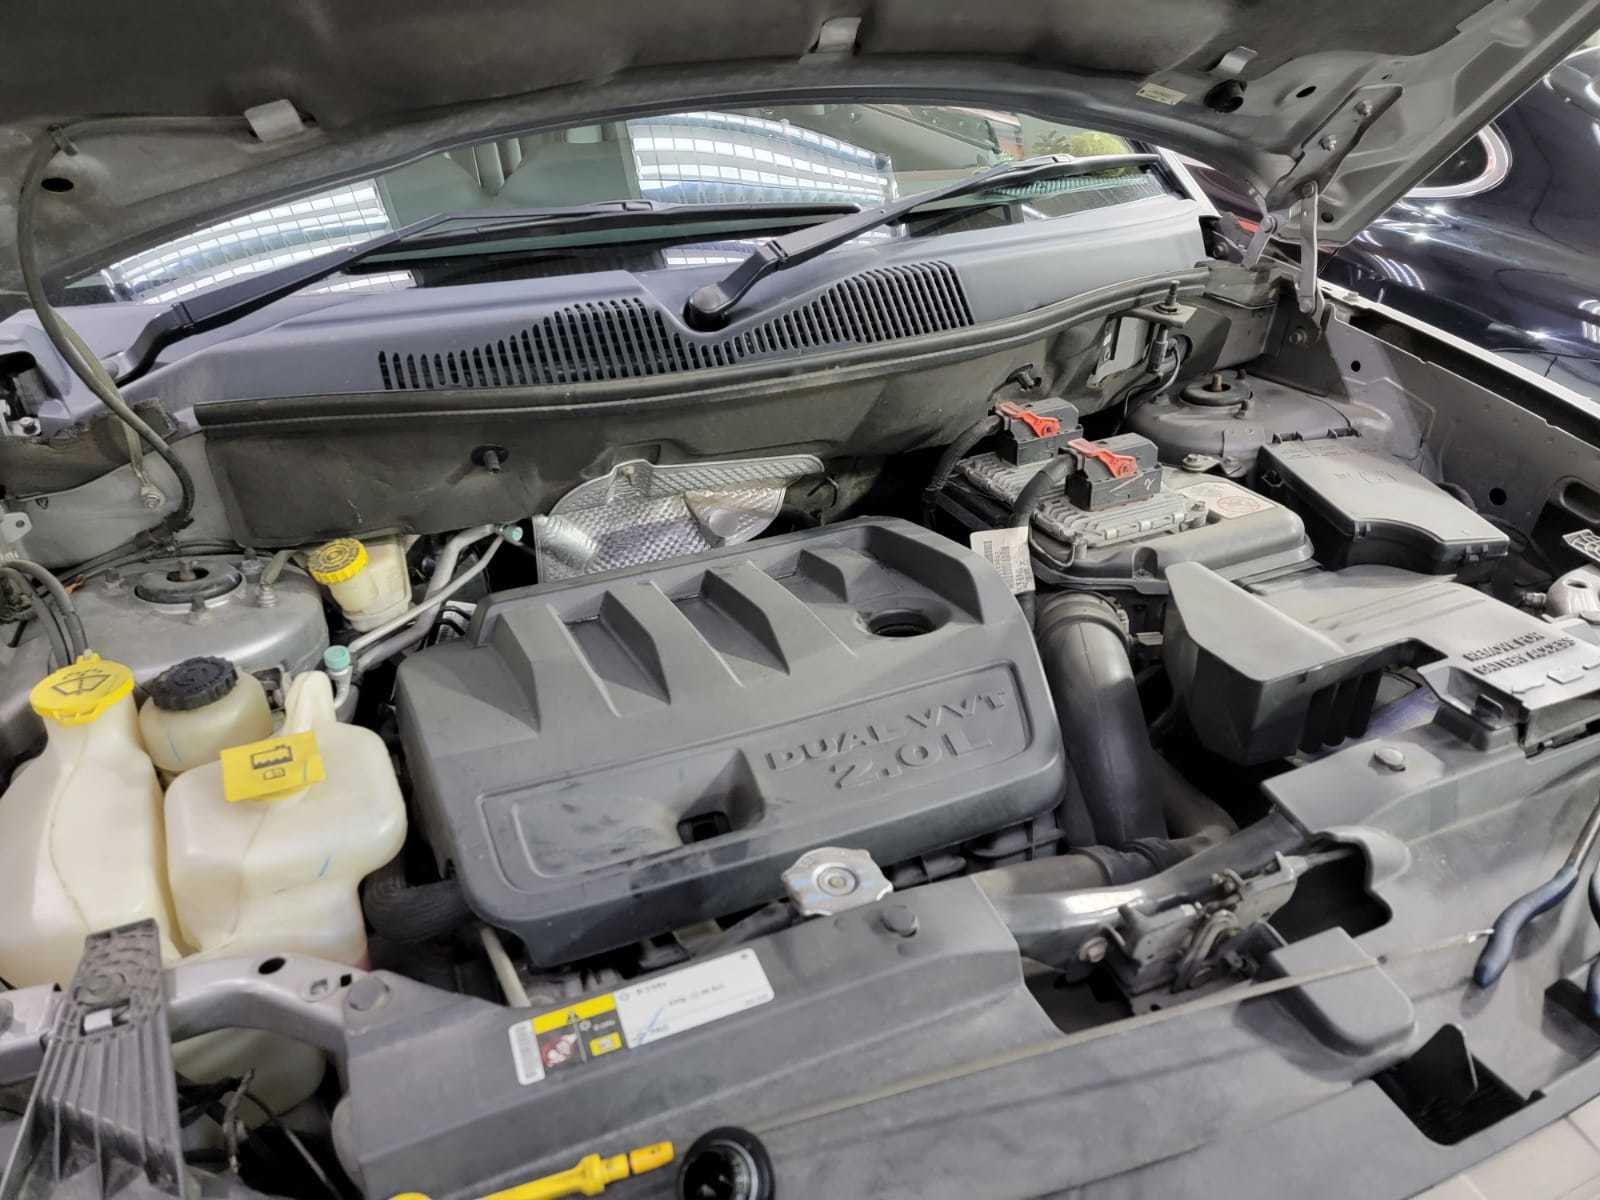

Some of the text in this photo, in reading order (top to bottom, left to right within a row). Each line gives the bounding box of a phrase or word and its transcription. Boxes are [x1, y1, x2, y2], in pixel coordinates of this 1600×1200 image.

[765, 691, 1005, 770] DUAL VVT
[830, 731, 992, 789] 2.0L
